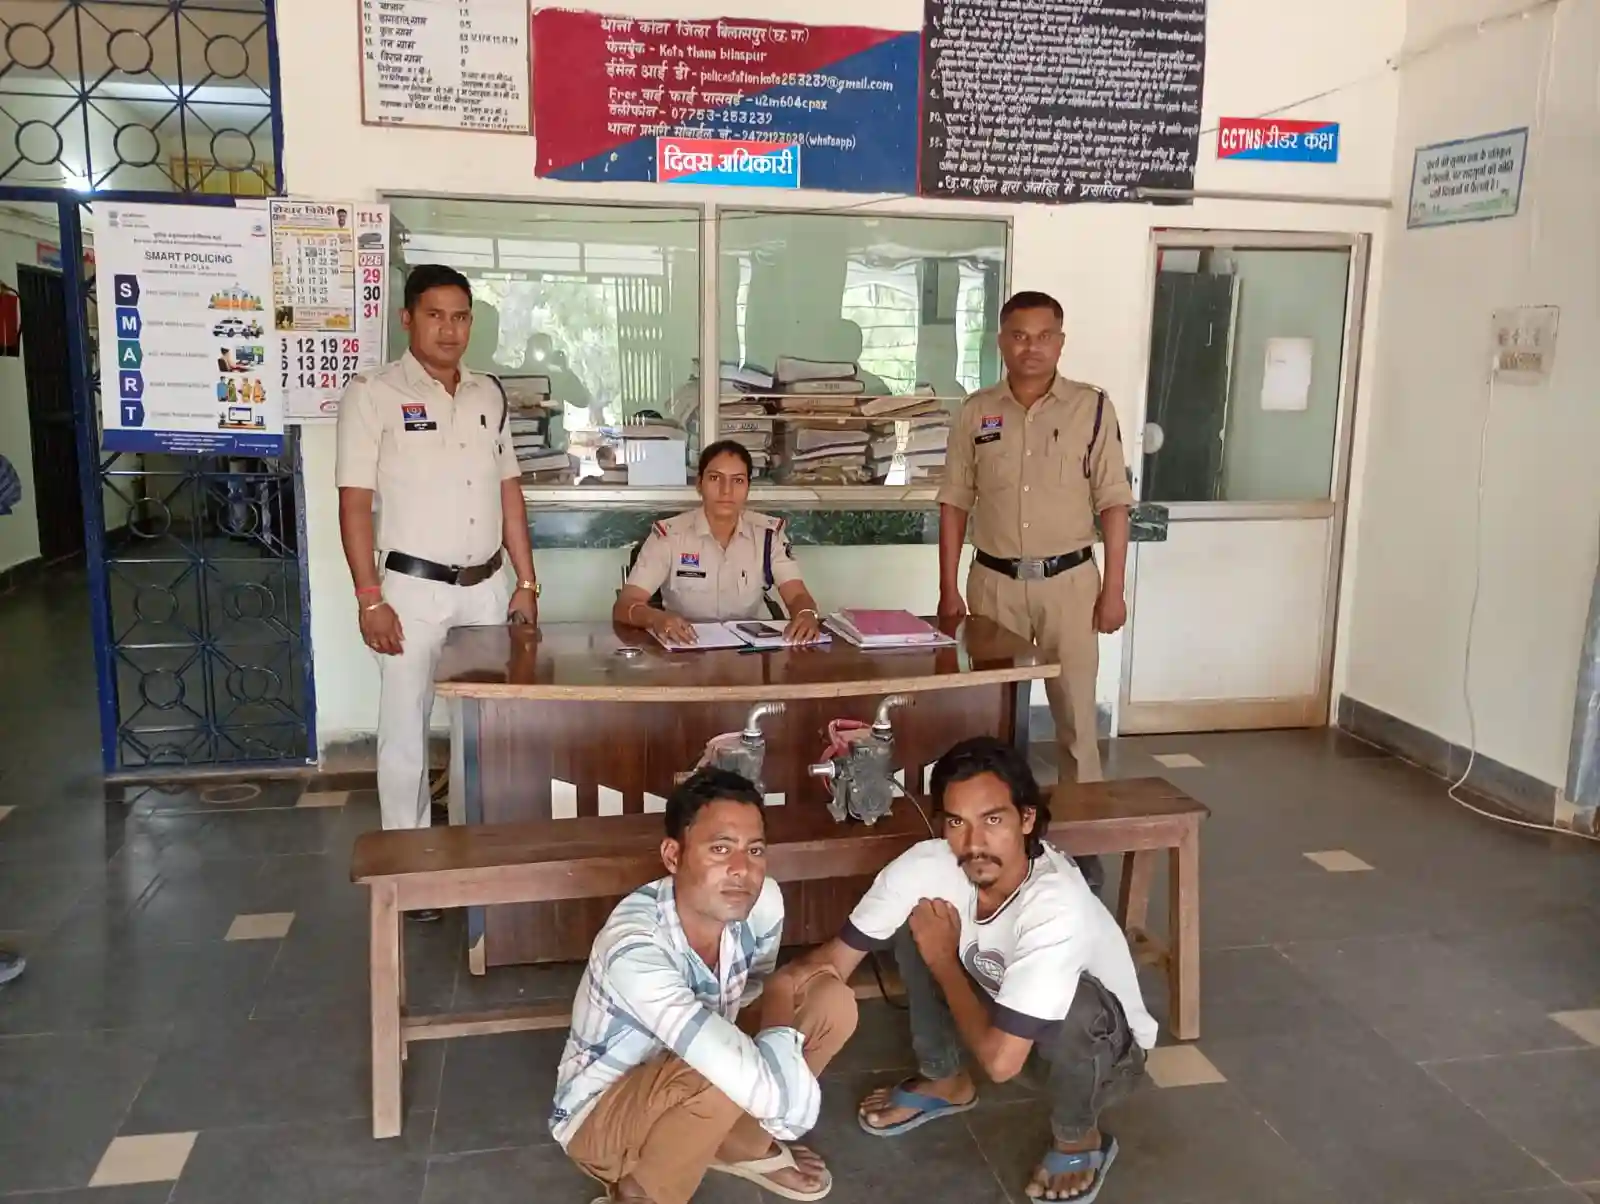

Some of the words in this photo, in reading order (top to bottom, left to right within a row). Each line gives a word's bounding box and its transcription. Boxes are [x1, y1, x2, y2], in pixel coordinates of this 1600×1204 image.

[676, 19, 711, 38] जिला
[1303, 132, 1336, 153] कक्ष
[664, 144, 713, 172] दिवस
[718, 147, 793, 174] अधिकारी
[144, 251, 181, 262] SMART
[184, 252, 233, 264] POLICING
[363, 268, 381, 284] 29
[119, 282, 132, 298] S
[363, 286, 381, 301] 30
[363, 303, 380, 318] 31
[121, 315, 137, 330] M
[297, 338, 315, 353] 12
[320, 338, 338, 353] 19
[342, 338, 360, 353] 26
[123, 347, 137, 362] A
[297, 355, 315, 371] 13
[320, 355, 338, 371] 20
[342, 355, 359, 371] 27
[124, 377, 138, 392] R
[297, 373, 315, 388] 14
[321, 373, 337, 388] 21
[342, 373, 358, 388] 2
[125, 406, 137, 421] T
